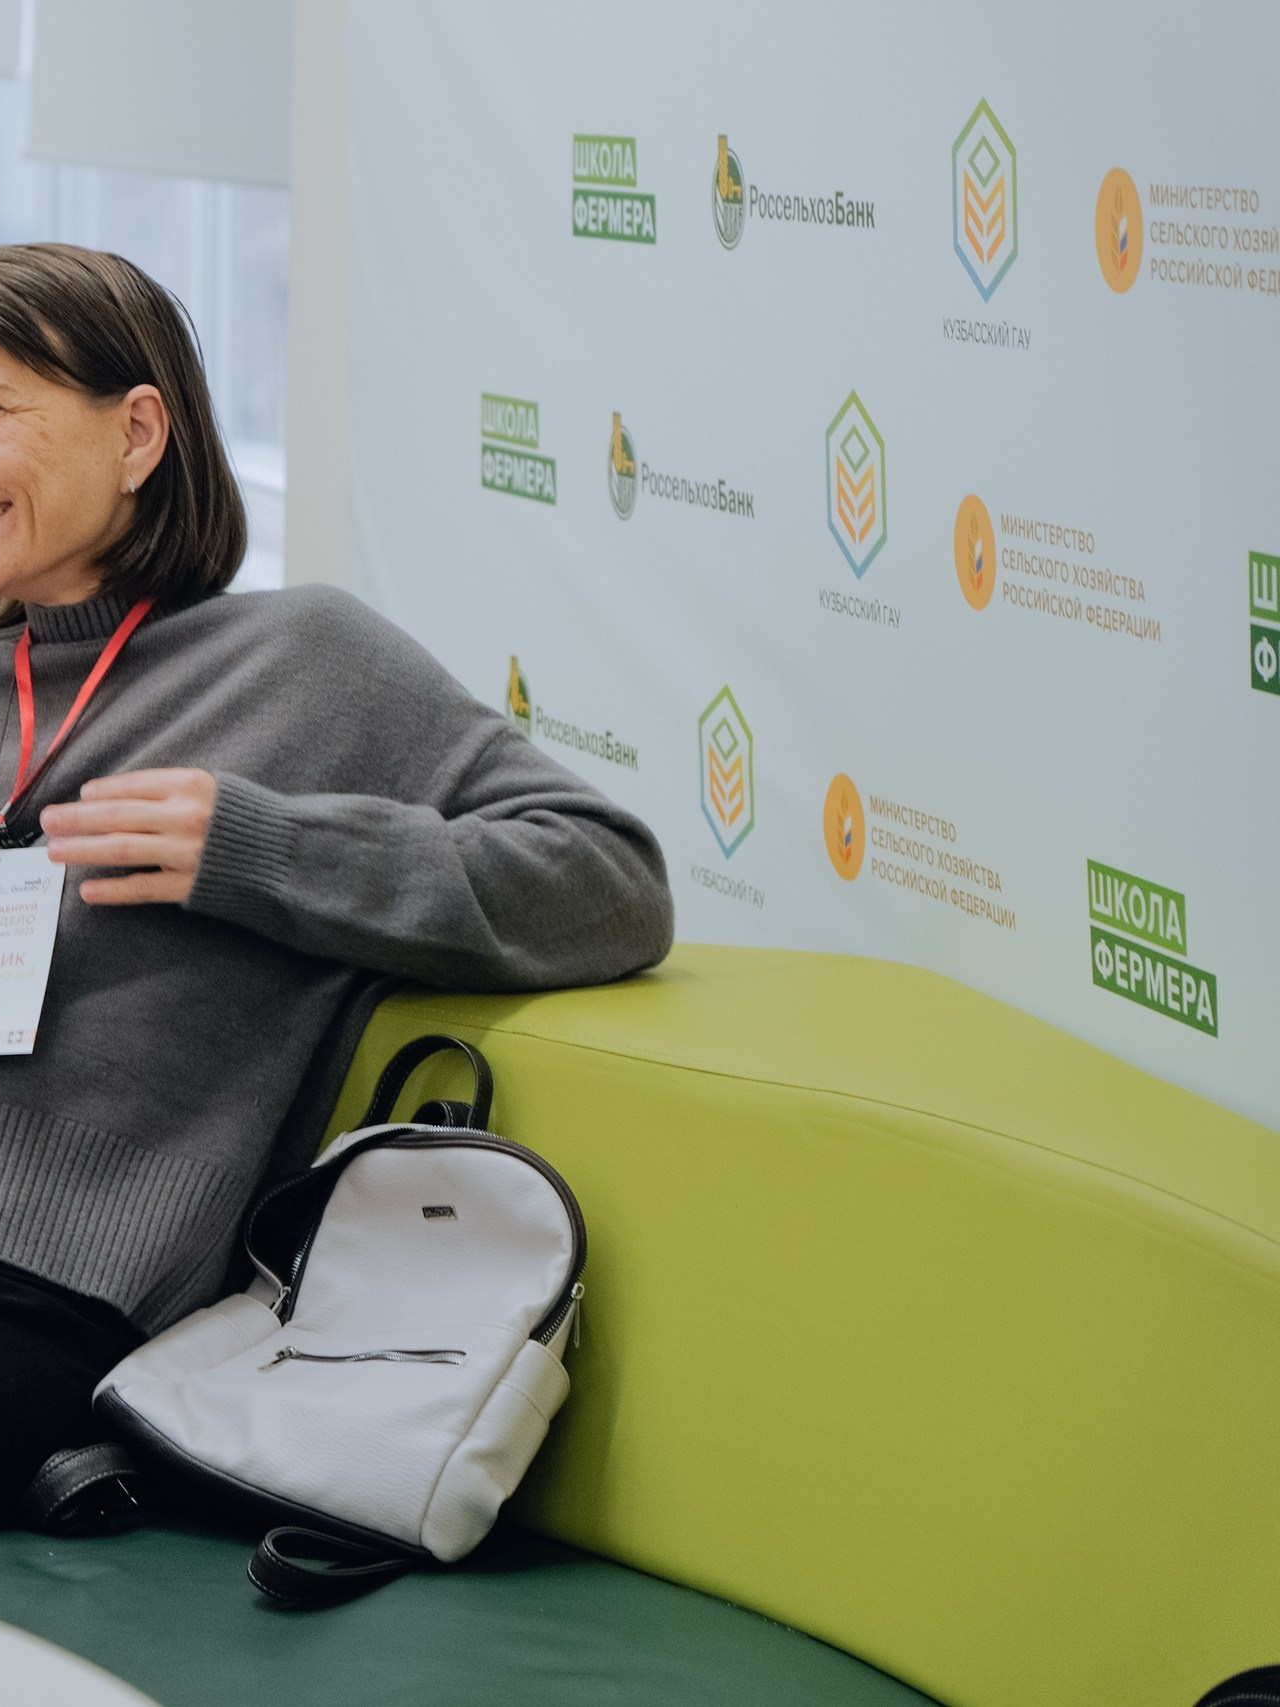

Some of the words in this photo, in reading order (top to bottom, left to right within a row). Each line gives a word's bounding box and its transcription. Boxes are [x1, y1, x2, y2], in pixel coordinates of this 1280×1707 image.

[575, 141, 635, 179] ШКОЛА
[574, 195, 654, 237] ФЕРМЕРА
[749, 185, 875, 228] РоссельхозБанк
[1150, 184, 1259, 212] МИНИСТЕРСТВО
[1150, 221, 1228, 249] СЕЛЬСКОГО
[1151, 258, 1242, 288] РОССИЙСКОЙ
[1247, 269, 1280, 296] ФЕД
[943, 318, 1009, 347] КУЗБАССКИЙ
[1011, 326, 1031, 350] ГАУ
[483, 399, 537, 440] ШКОЛА
[483, 449, 555, 497] ФЕРМЕРА
[642, 462, 754, 518] РоссельхозБанк
[1001, 513, 1095, 554] МИНИСТЕРСТВО
[1002, 548, 1069, 583] СЕЛЬСКОГО
[1072, 564, 1145, 602] ХОЗЯЙСТВА
[819, 589, 881, 624] КУЗБАССКИЙ
[883, 604, 901, 628] ГАУ
[1003, 582, 1082, 621] РОССИЙСКОЙ
[1086, 604, 1161, 642] ФЕДЕРАЦИИ
[536, 705, 639, 770] РоссельхозБанк
[870, 795, 956, 842] МИНИСТЕРСТВО
[871, 827, 934, 866] СЕЛЬСКОГО
[937, 850, 1002, 892] ХОЗЯЙСТВА
[872, 858, 948, 902] РОССИЙСКОЙ
[951, 888, 1016, 931] ФЕДЕРАЦИИ
[1091, 869, 1183, 945] ШКОЛА
[1095, 939, 1215, 1027] ФЕРМЕРА
